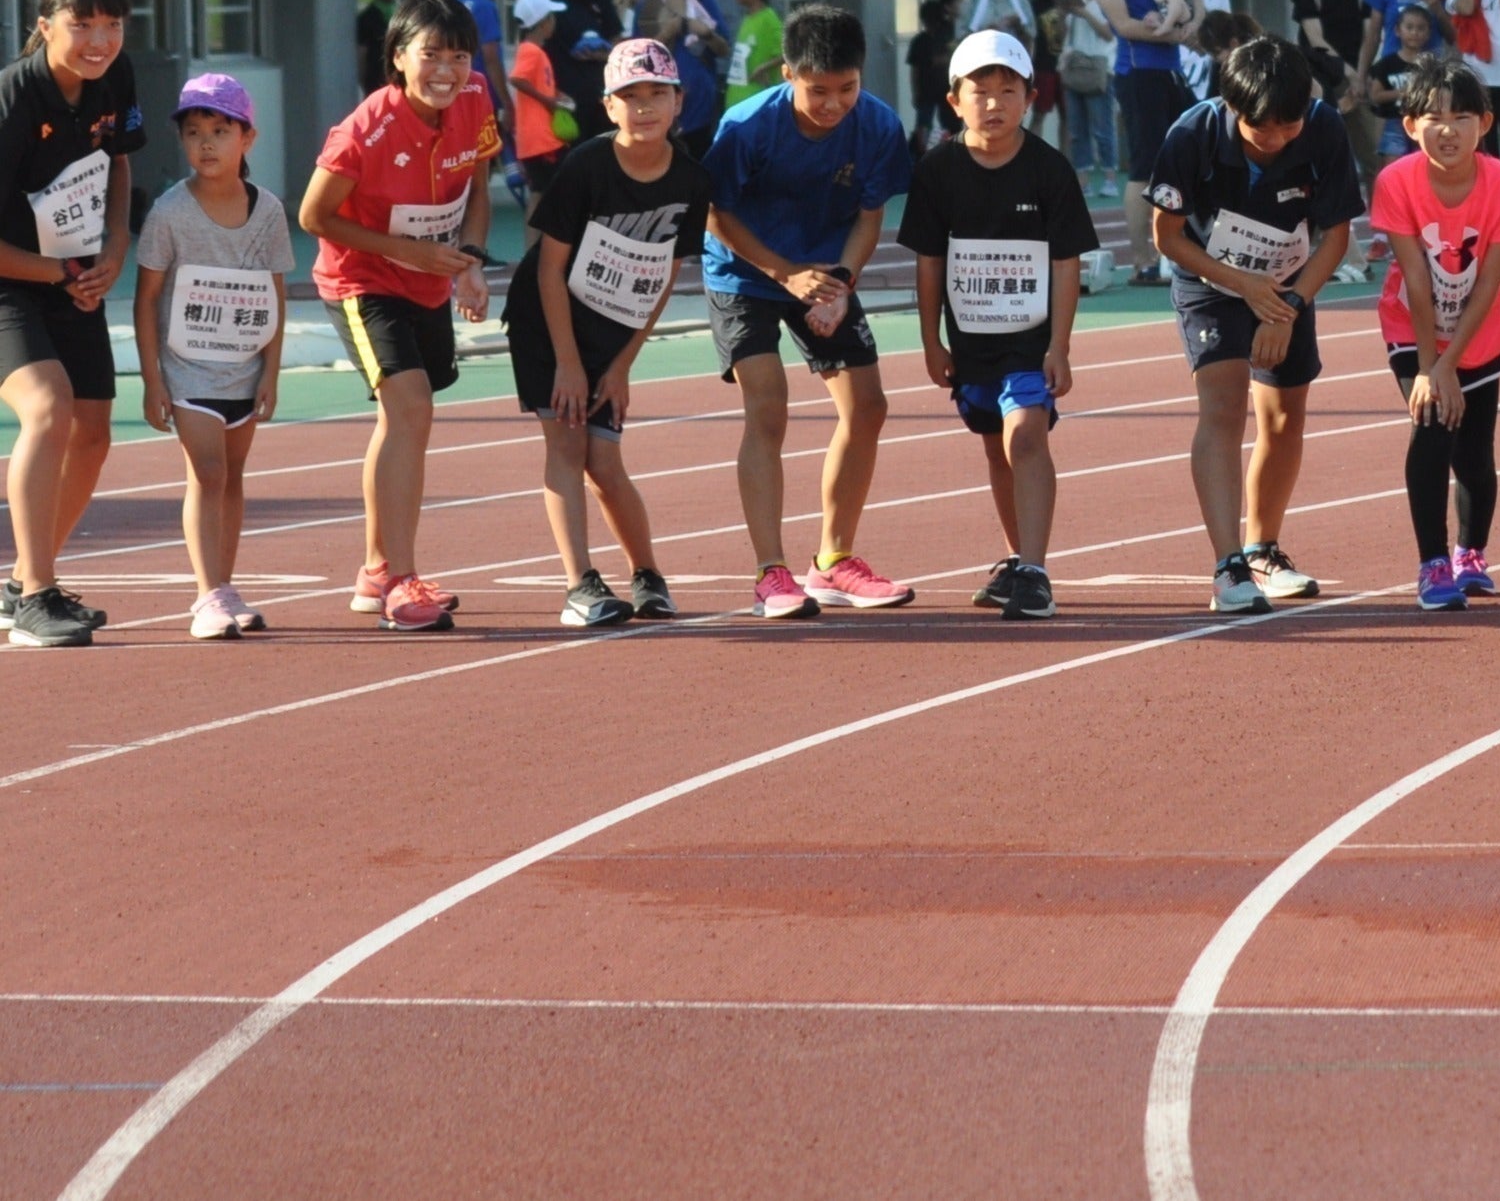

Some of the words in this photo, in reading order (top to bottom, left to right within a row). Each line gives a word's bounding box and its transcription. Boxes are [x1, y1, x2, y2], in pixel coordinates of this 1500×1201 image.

[53, 203, 83, 227] 谷口
[954, 265, 1034, 276] CHALLENGER
[952, 277, 1038, 295] 大川原皇輝
[189, 292, 268, 305] CHALLENGER
[976, 314, 1008, 323] RUNNING
[1010, 314, 1030, 323] CLUB
[208, 340, 239, 352] RUNNING
